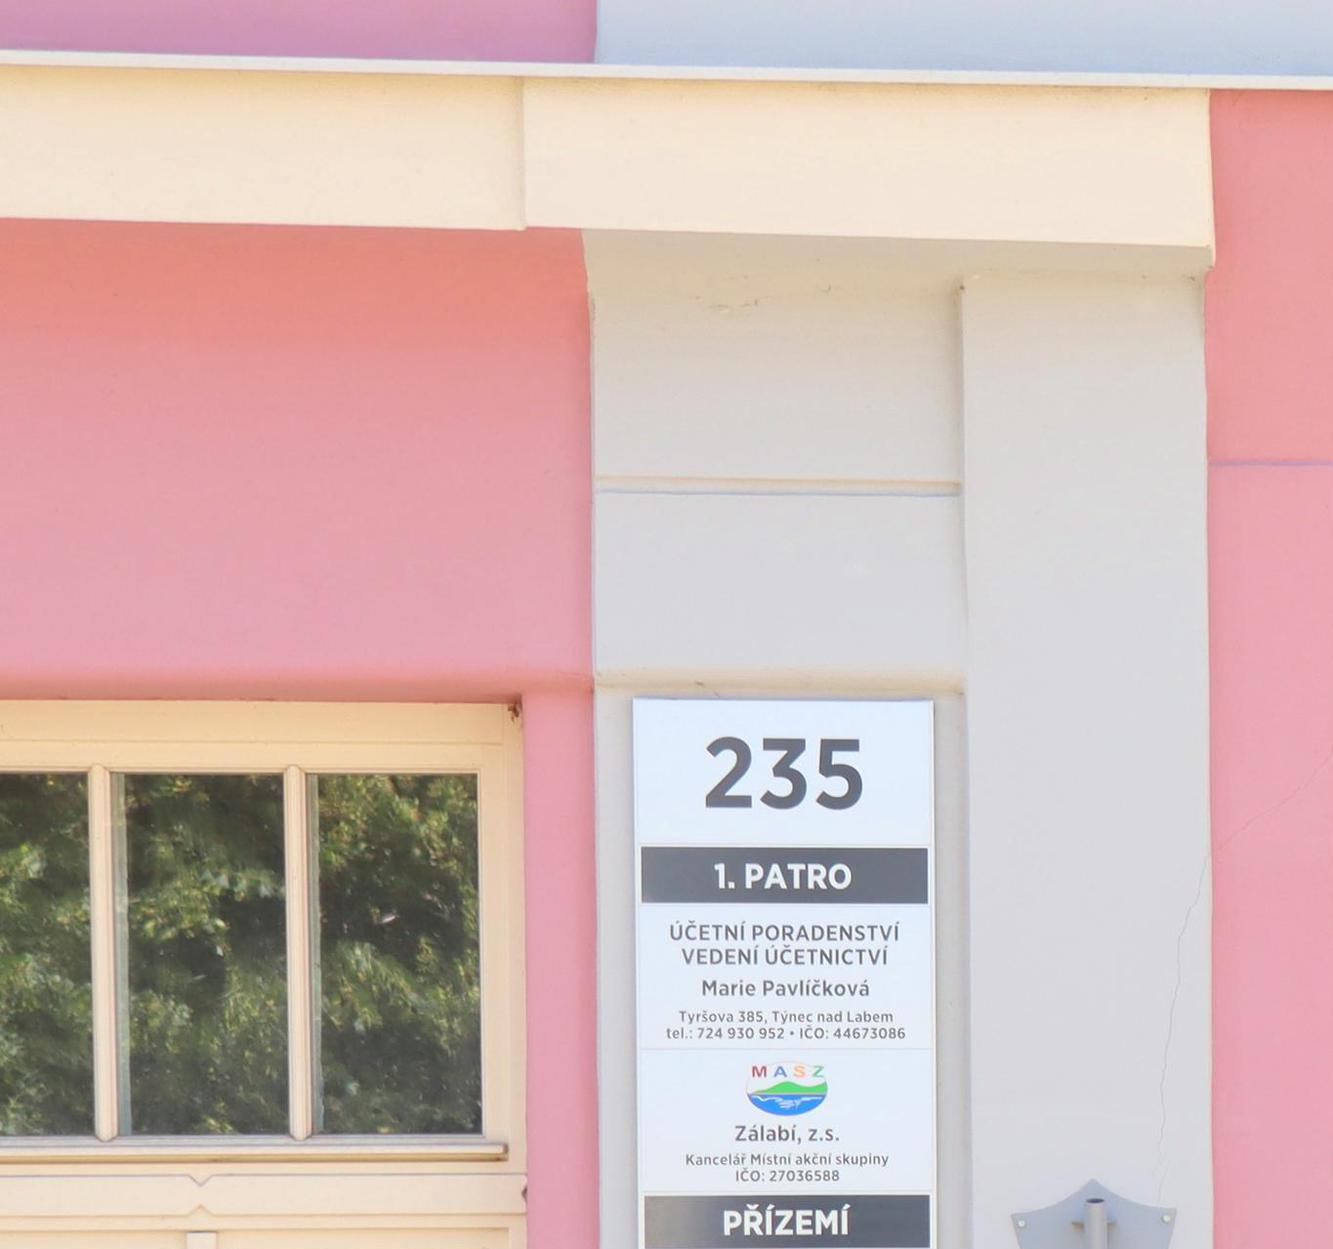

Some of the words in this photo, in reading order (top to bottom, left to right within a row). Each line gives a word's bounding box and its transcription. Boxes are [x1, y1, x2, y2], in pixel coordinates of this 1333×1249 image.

[705, 736, 863, 811] 235
[713, 862, 736, 889] 1.
[745, 863, 852, 890] PATRO
[670, 920, 746, 941] ÚČETNÍ
[752, 921, 900, 942] PORADENSTVÍ
[681, 944, 759, 965] VEDENÍ
[765, 944, 888, 966] ÚČETNICTVÍ
[702, 979, 756, 997] Marie
[762, 979, 870, 997] Pavlíčková
[679, 1009, 734, 1025] Tyršova
[738, 1010, 768, 1025] 385,
[771, 1010, 813, 1027] Týnec
[817, 1010, 843, 1023] nad
[846, 1010, 894, 1023] Labem
[666, 1026, 693, 1040] tel.:
[697, 1027, 723, 1040] 724
[727, 1026, 755, 1040] 930
[758, 1026, 786, 1040] 952
[799, 1024, 829, 1040] IČO:
[832, 1027, 906, 1040] 44673086
[735, 1124, 802, 1145] Zálabí,
[808, 1128, 840, 1142] z.s.
[685, 1153, 747, 1166] Kancelář
[750, 1153, 791, 1166] Místní
[795, 1152, 832, 1166] akční
[835, 1152, 889, 1168] skupiny
[735, 1167, 765, 1183] IČO:
[769, 1169, 840, 1182] 27036588
[723, 1203, 851, 1236] PŘÍZEMÍ
